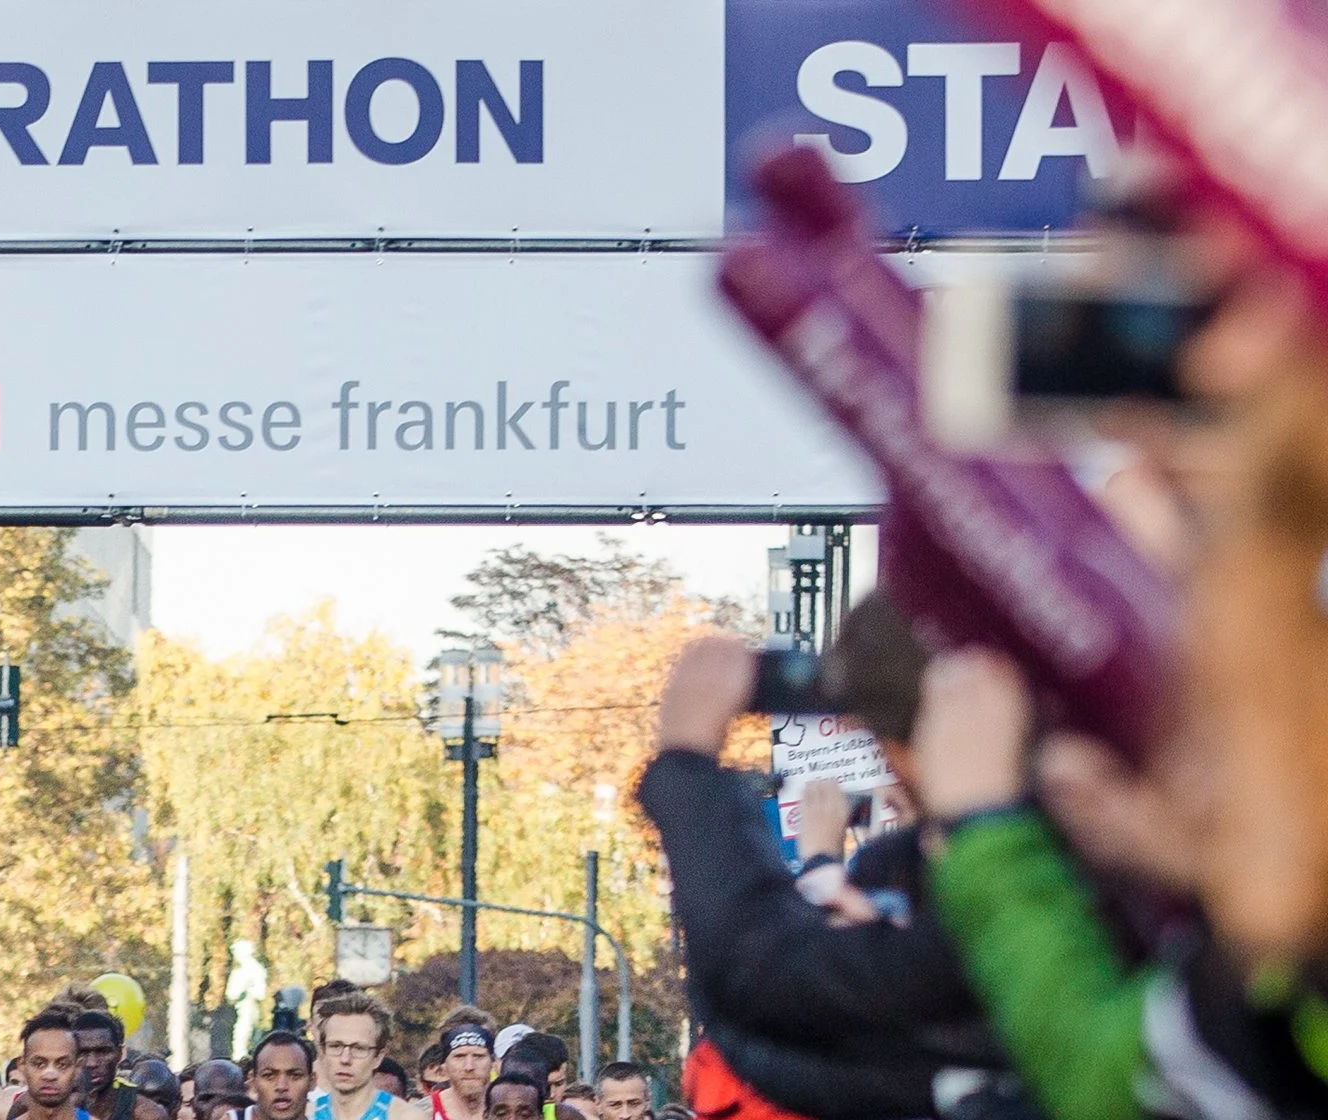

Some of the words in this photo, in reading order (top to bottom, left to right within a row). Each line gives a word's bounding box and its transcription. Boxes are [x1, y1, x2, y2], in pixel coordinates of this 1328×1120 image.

[795, 40, 1134, 183] STA
[48, 397, 303, 453] messe
[331, 379, 687, 453] frankfurt
